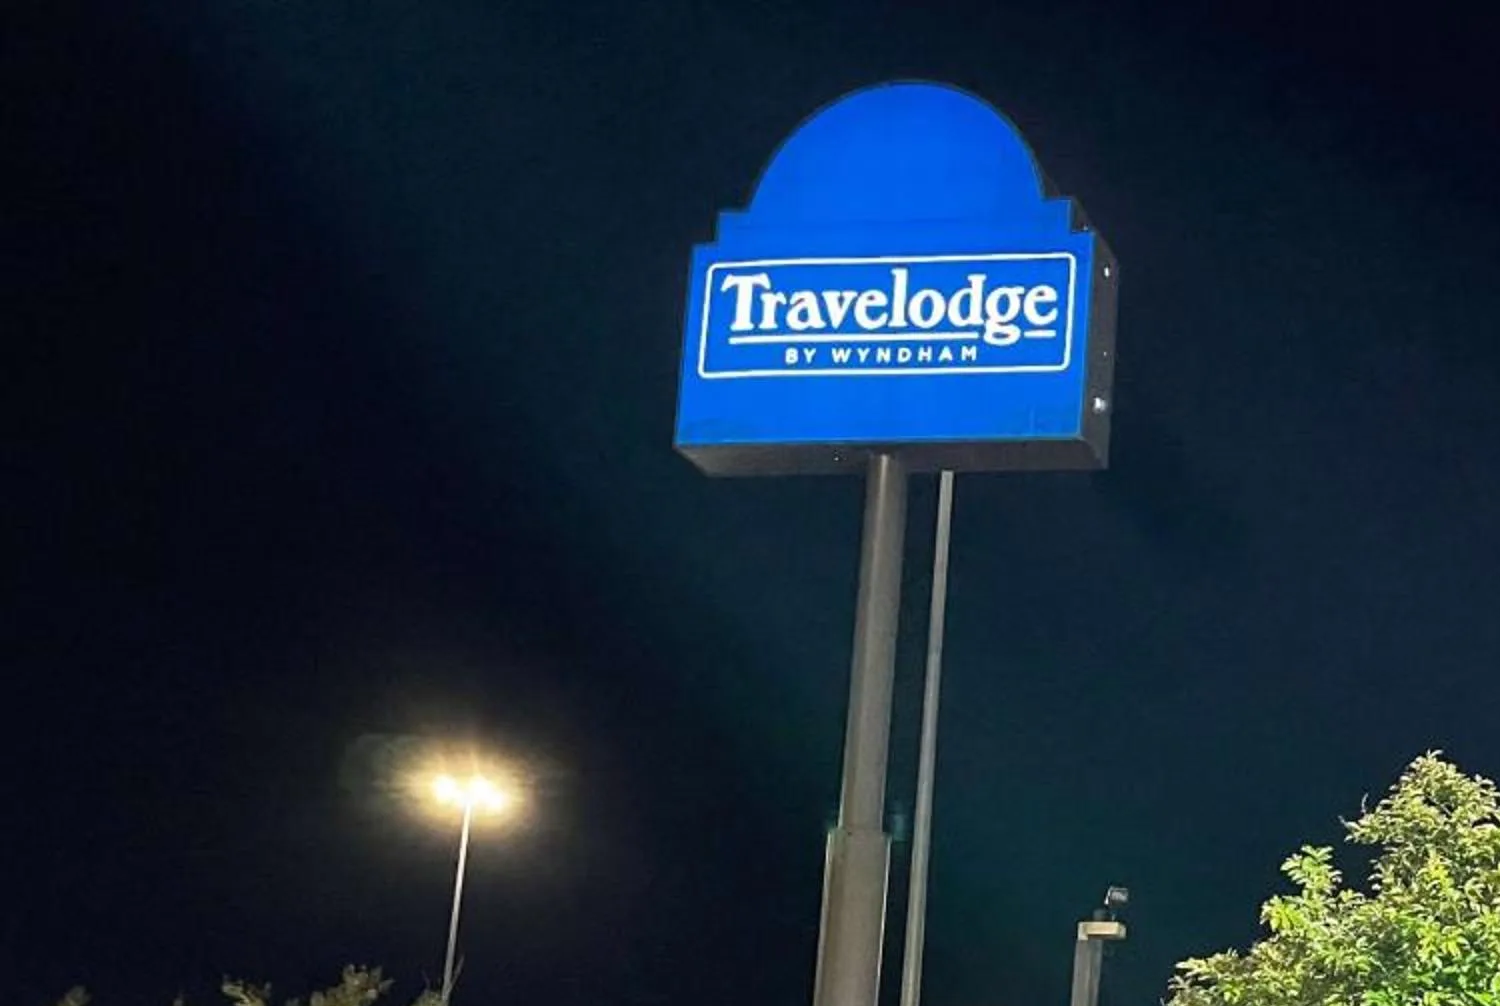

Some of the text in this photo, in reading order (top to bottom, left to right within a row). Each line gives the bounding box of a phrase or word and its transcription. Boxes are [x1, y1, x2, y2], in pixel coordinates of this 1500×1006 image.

[720, 268, 1058, 345] Travelodge
[785, 345, 978, 365] BY WYNDHAM
